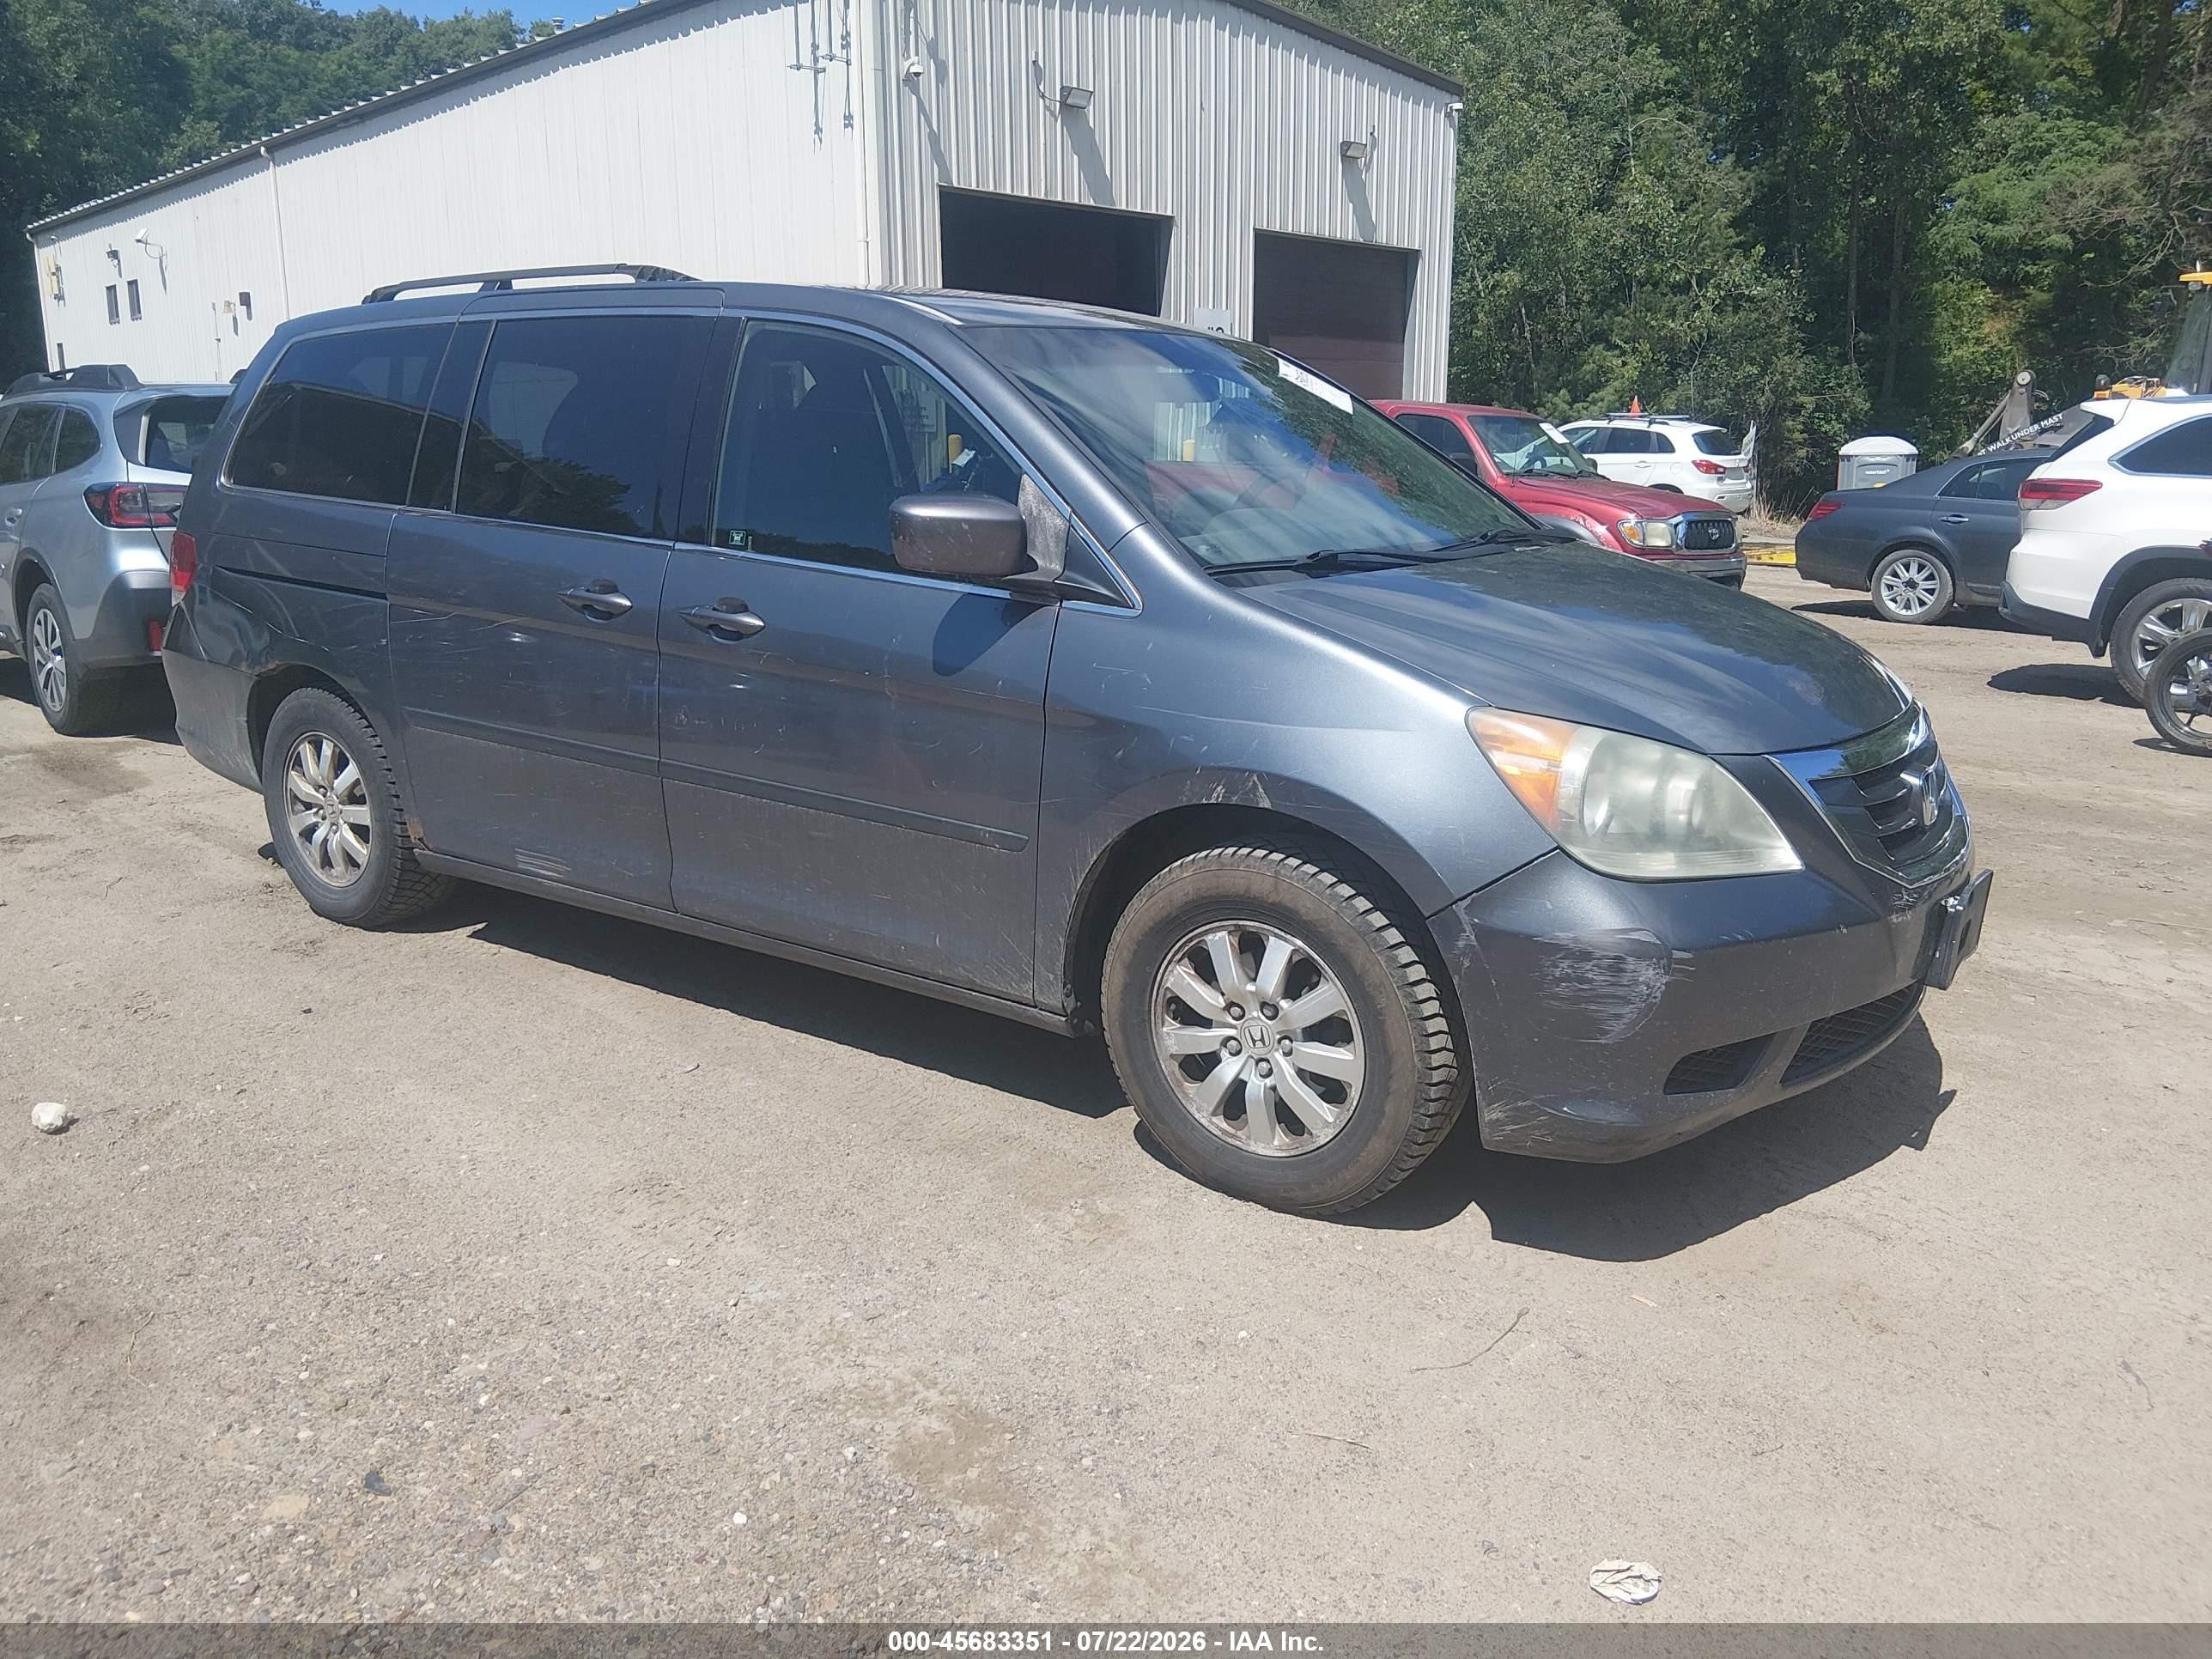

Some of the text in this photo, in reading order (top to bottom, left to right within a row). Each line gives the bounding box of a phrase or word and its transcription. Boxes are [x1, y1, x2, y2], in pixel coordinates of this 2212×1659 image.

[1987, 436, 2012, 452] WALK
[2010, 423, 2040, 441] UNDER
[2040, 412, 2063, 428] MAST
